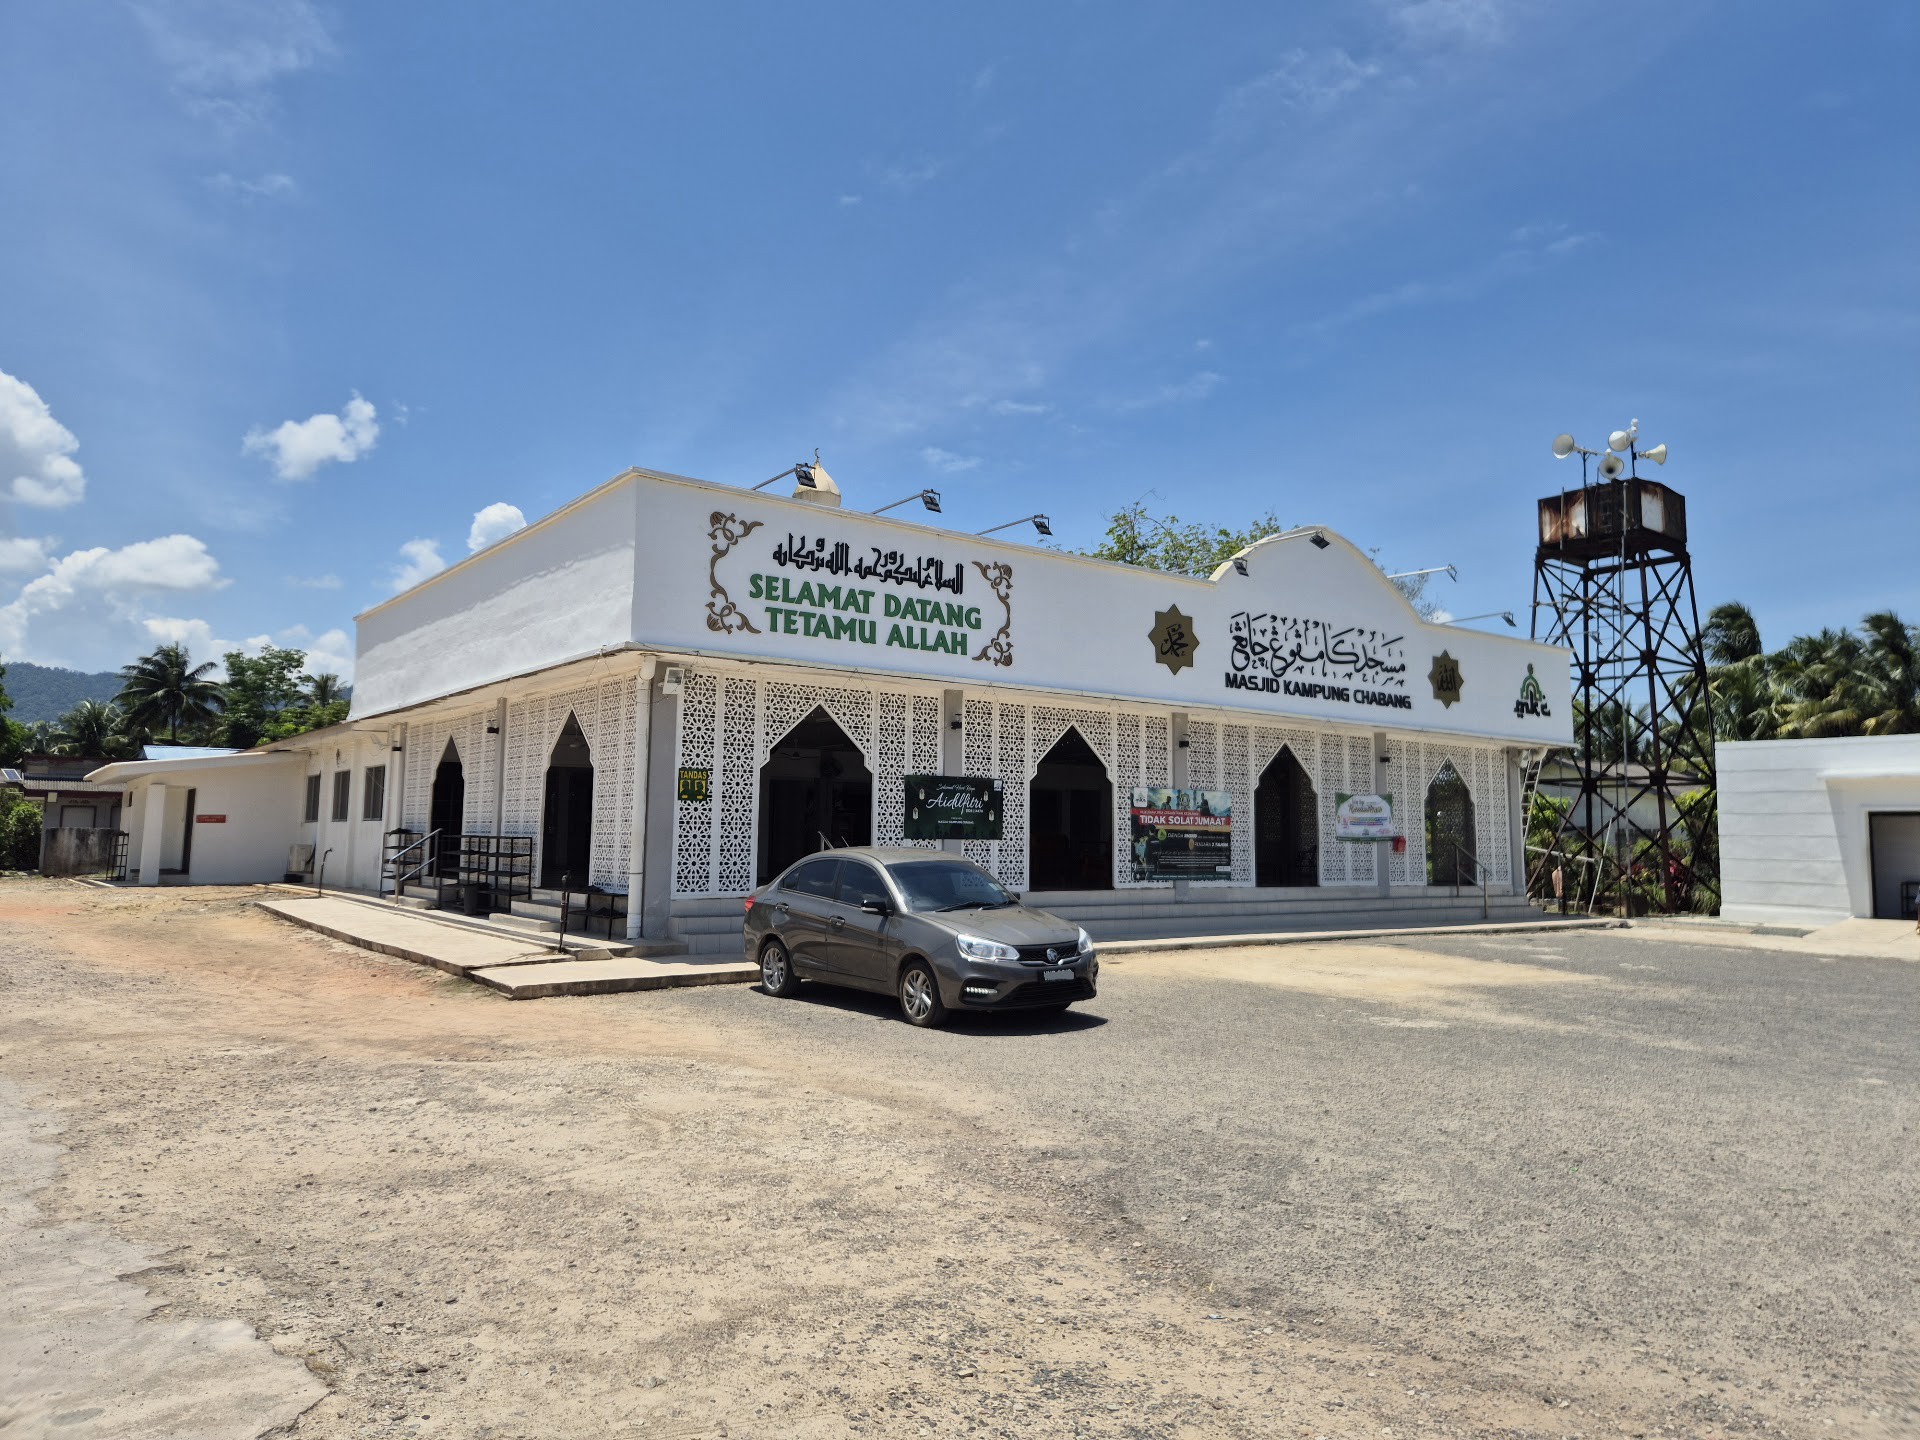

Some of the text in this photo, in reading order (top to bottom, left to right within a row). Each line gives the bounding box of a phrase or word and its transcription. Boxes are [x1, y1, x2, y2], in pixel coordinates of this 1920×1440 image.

[749, 573, 982, 630] SELAMAT DATANG
[764, 607, 968, 656] TETAMU ALLAH
[1224, 672, 1412, 709] MASJID KAMPUNG CHABANG
[679, 770, 707, 780] TANDAS
[1139, 815, 1226, 825] TIDAK SOLAT JUMAAT
